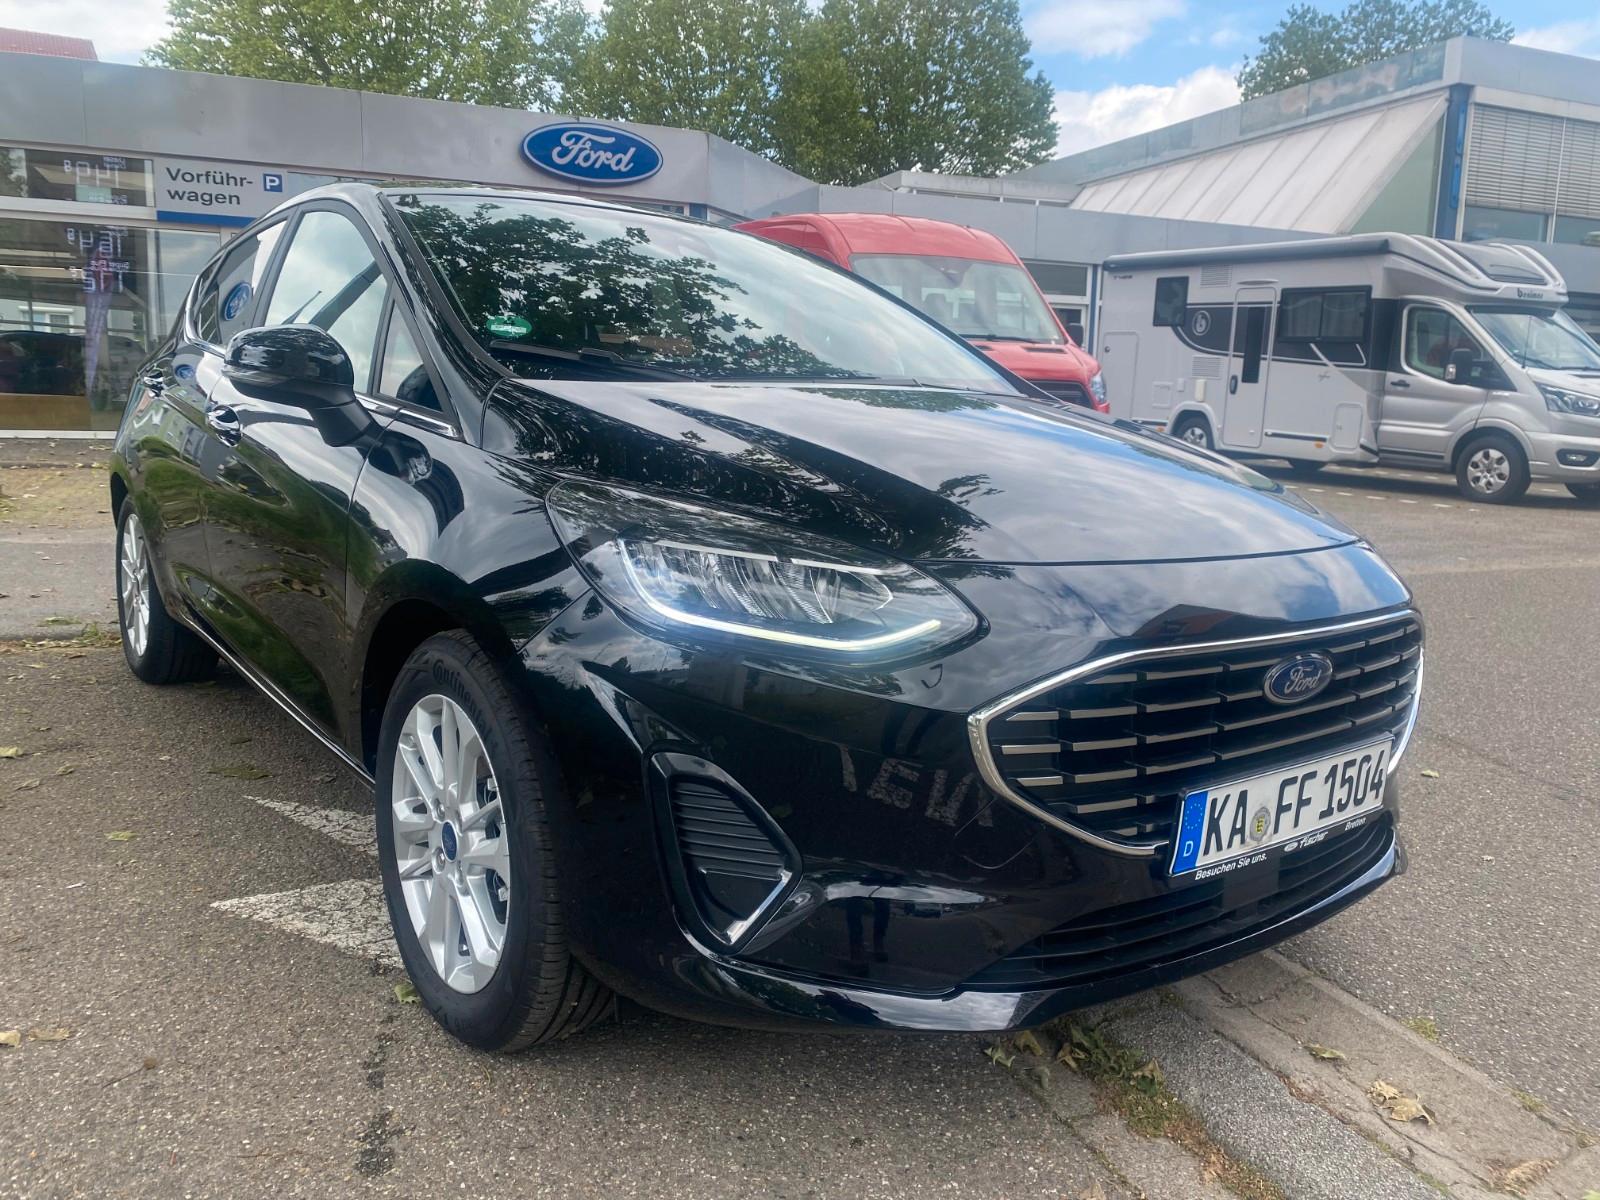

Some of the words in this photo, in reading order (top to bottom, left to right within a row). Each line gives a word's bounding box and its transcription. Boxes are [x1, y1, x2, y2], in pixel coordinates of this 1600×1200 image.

[552, 130, 636, 172] Ford
[166, 167, 253, 187] Vorführ-
[167, 189, 240, 206] wagen
[1284, 665, 1321, 694] Ford
[1183, 841, 1193, 857] D
[1203, 789, 1248, 856] KA
[1195, 862, 1236, 880] Besuchen
[1237, 857, 1251, 868] Sie
[1251, 853, 1267, 864] uns.
